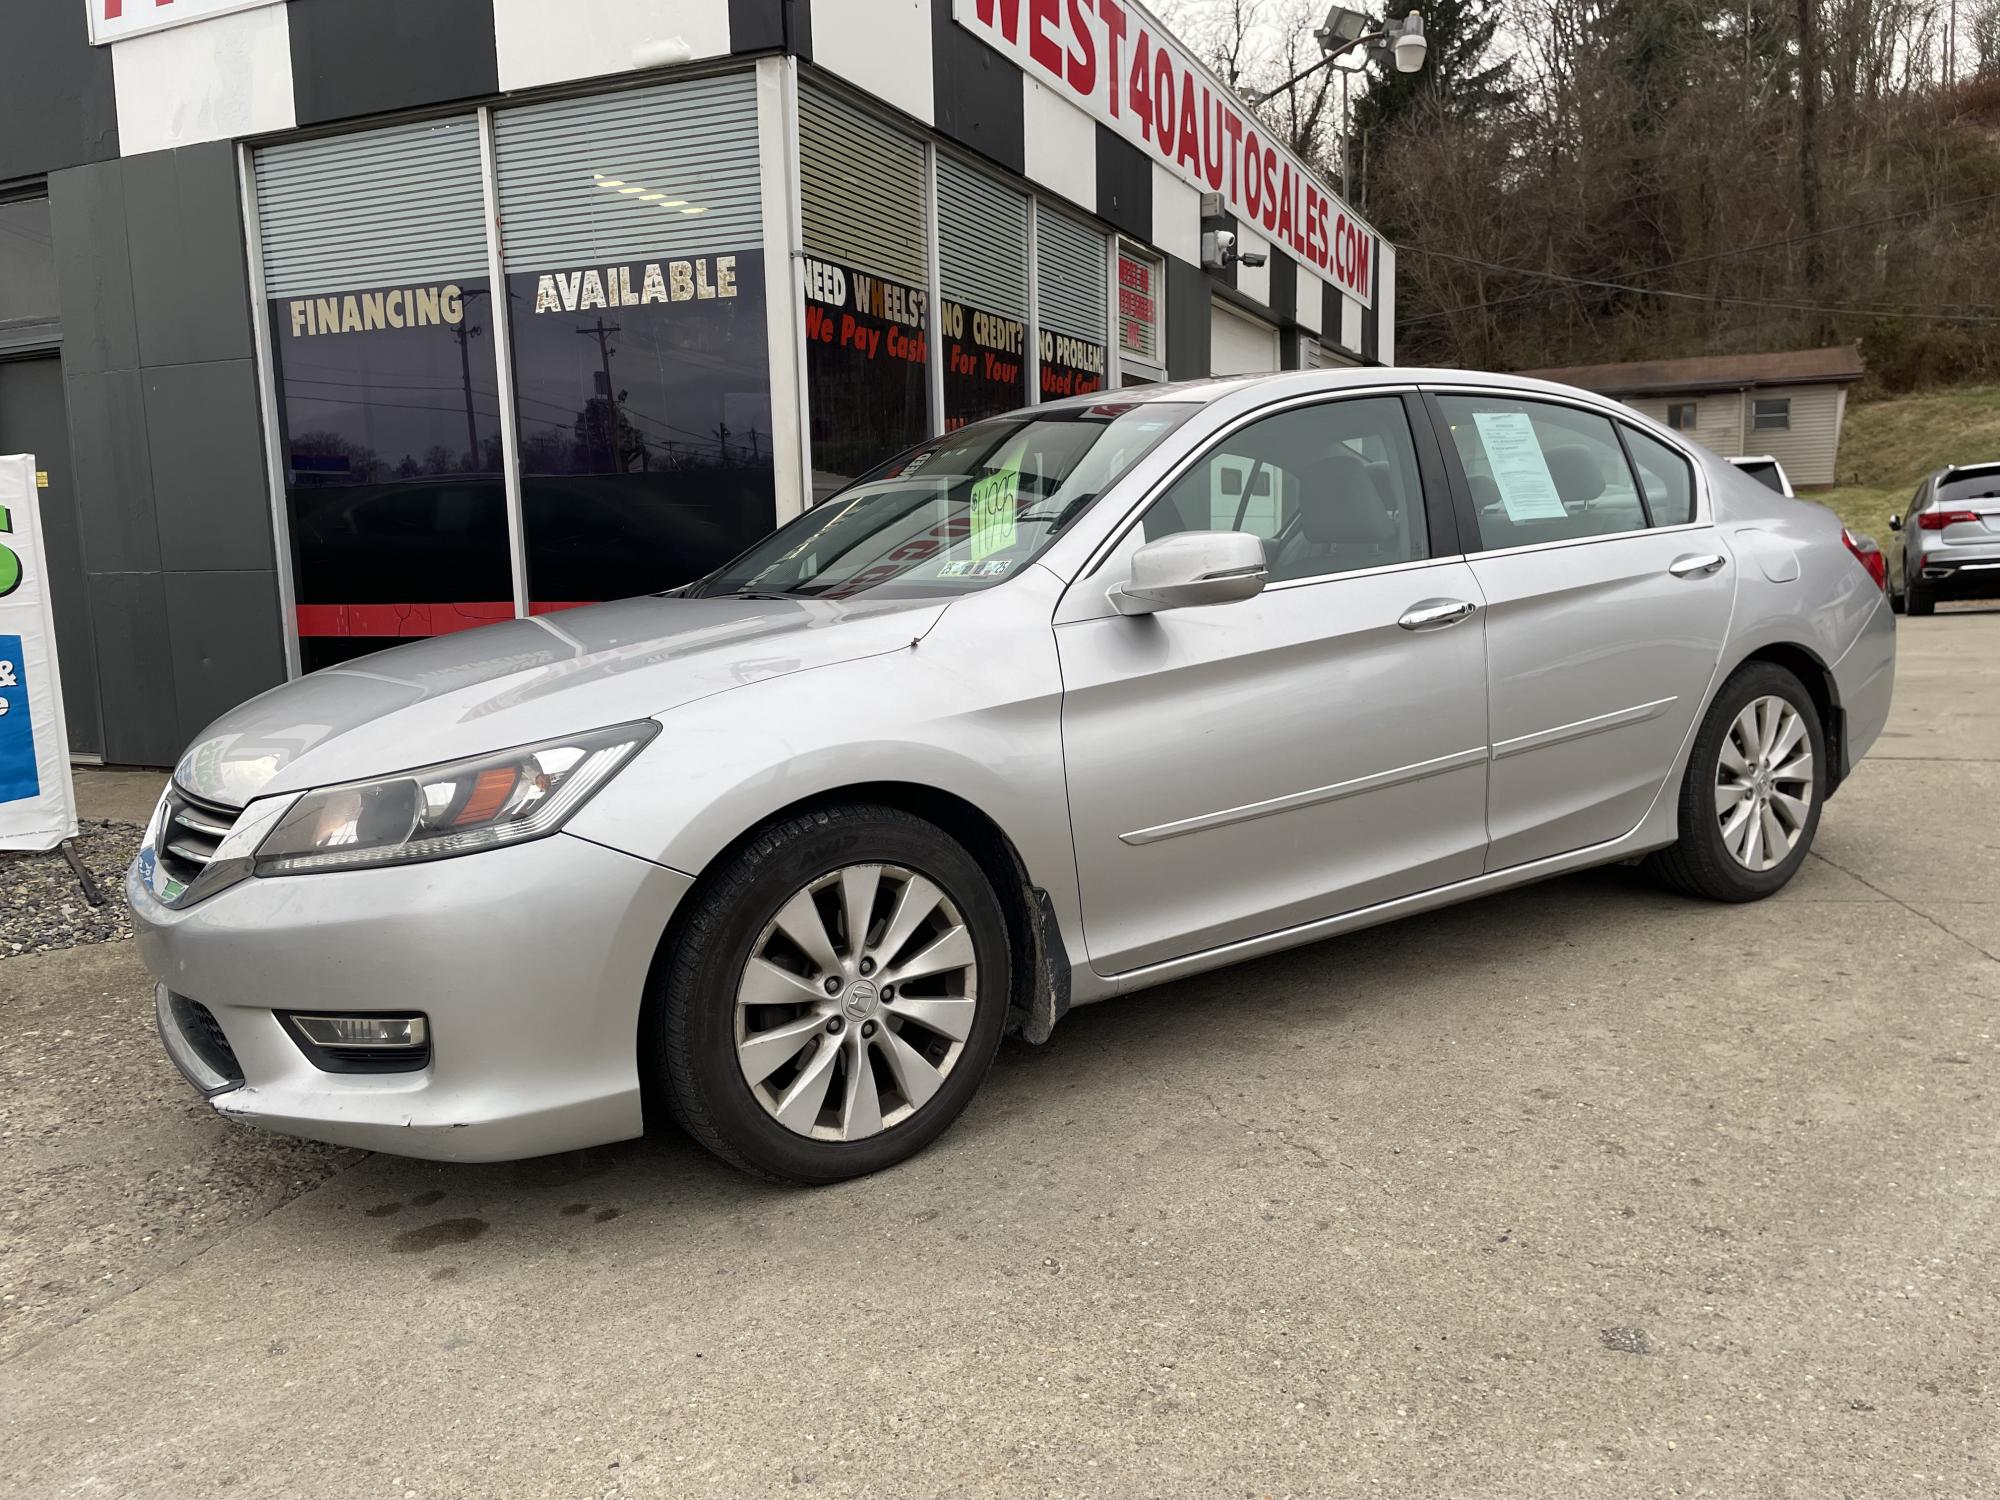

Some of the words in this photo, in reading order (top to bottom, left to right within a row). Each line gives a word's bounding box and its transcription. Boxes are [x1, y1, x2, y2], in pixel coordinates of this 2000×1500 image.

[290, 284, 464, 337] FINANCING
[535, 255, 737, 313] AVAILABLE
[803, 258, 847, 307] NEED
[852, 272, 927, 330] WHEELS?
[942, 302, 964, 340] NO
[973, 311, 1024, 356] CREDIT?
[1039, 330, 1054, 363] NO
[1057, 335, 1104, 376] PROBLEM!
[806, 306, 834, 343] We
[840, 313, 881, 360] Pay
[887, 325, 928, 364] Cash
[951, 344, 978, 376] For
[985, 352, 1019, 384] Your
[1042, 366, 1073, 396] Used
